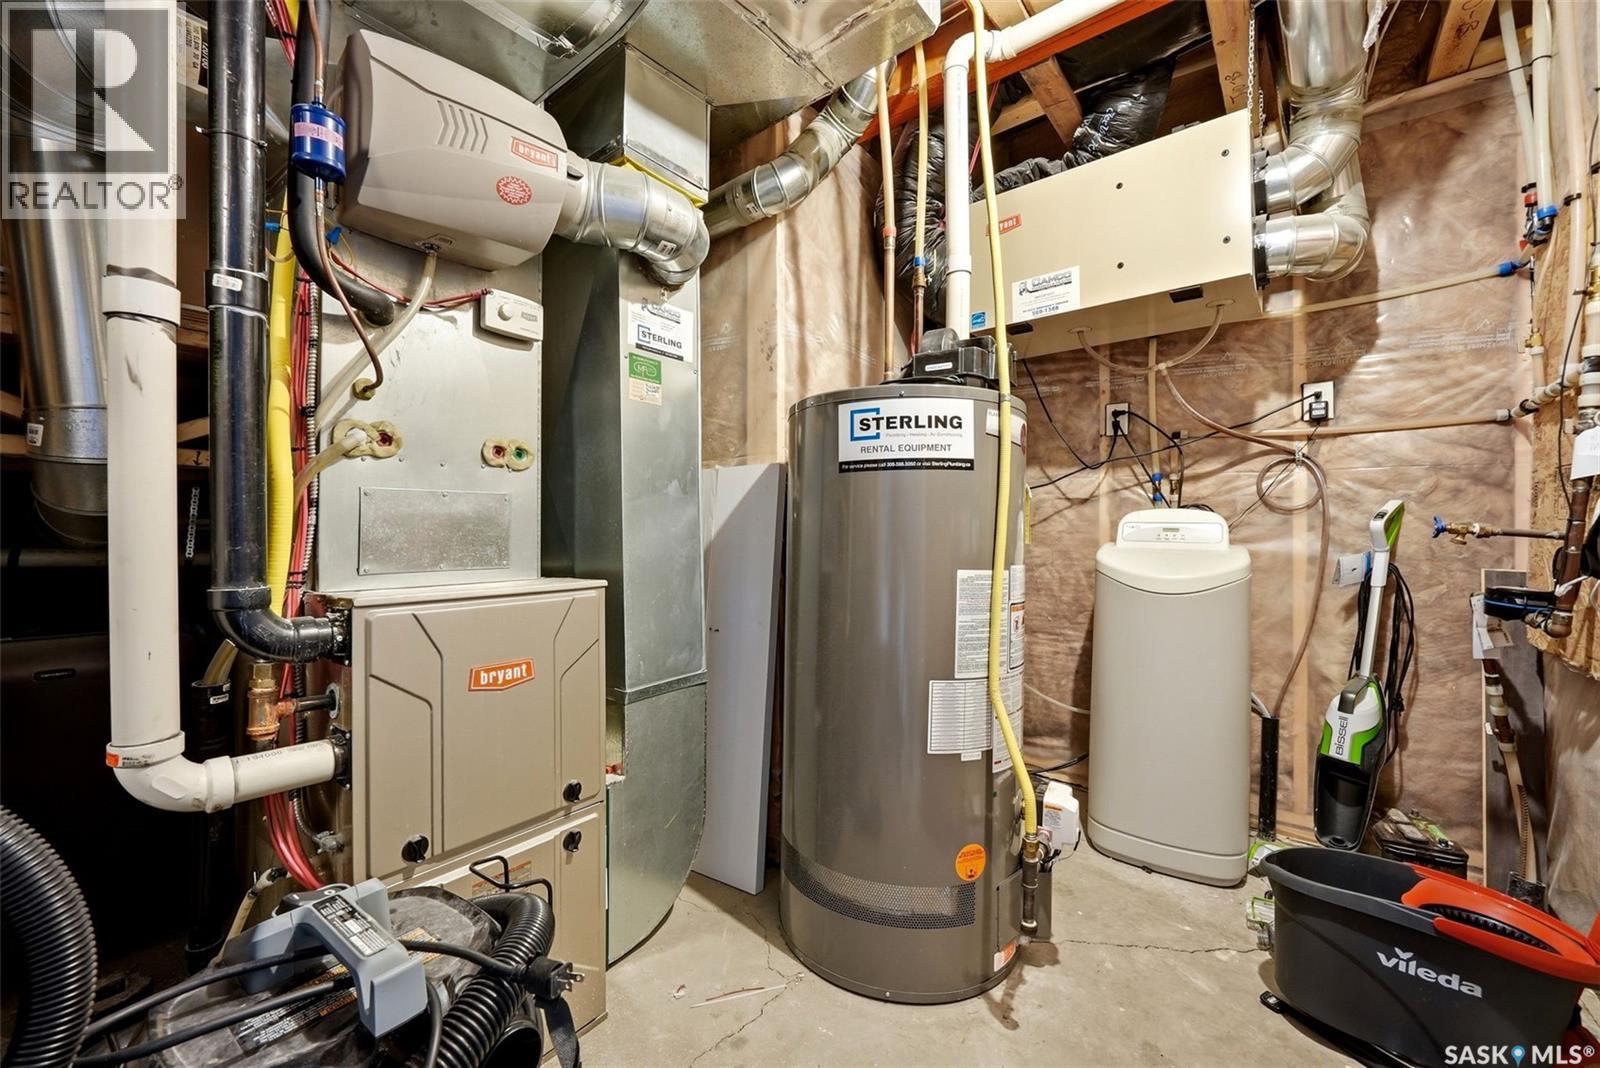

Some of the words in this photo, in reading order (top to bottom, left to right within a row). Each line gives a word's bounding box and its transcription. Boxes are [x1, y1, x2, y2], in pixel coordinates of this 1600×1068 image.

[518, 141, 552, 165] bryant
[641, 330, 683, 350] STERLING
[859, 414, 963, 432] STERLING
[860, 444, 895, 454] RENTAL
[898, 443, 953, 453] EQUIPMENT
[480, 662, 528, 686] bryant
[1376, 946, 1483, 998] vileda
